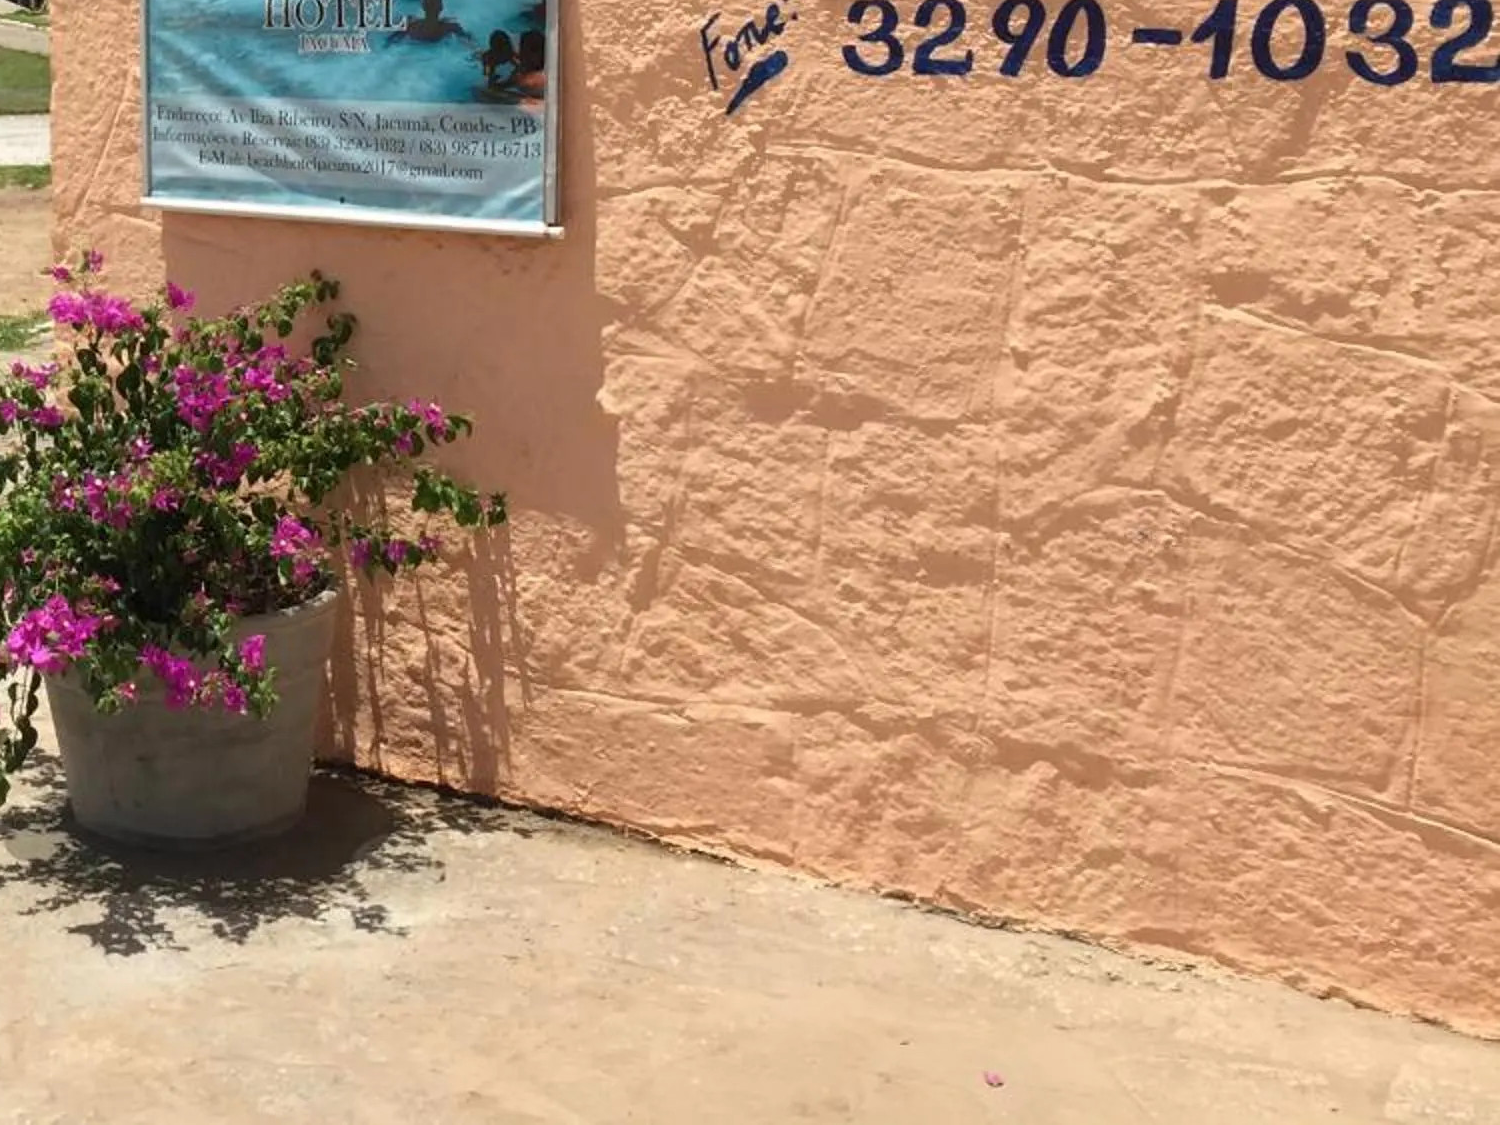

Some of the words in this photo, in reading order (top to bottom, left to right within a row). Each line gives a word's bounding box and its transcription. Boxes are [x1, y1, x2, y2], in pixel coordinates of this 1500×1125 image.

[439, 115, 494, 134] Conde
[510, 116, 539, 135] PB
[419, 138, 447, 156] (83)
